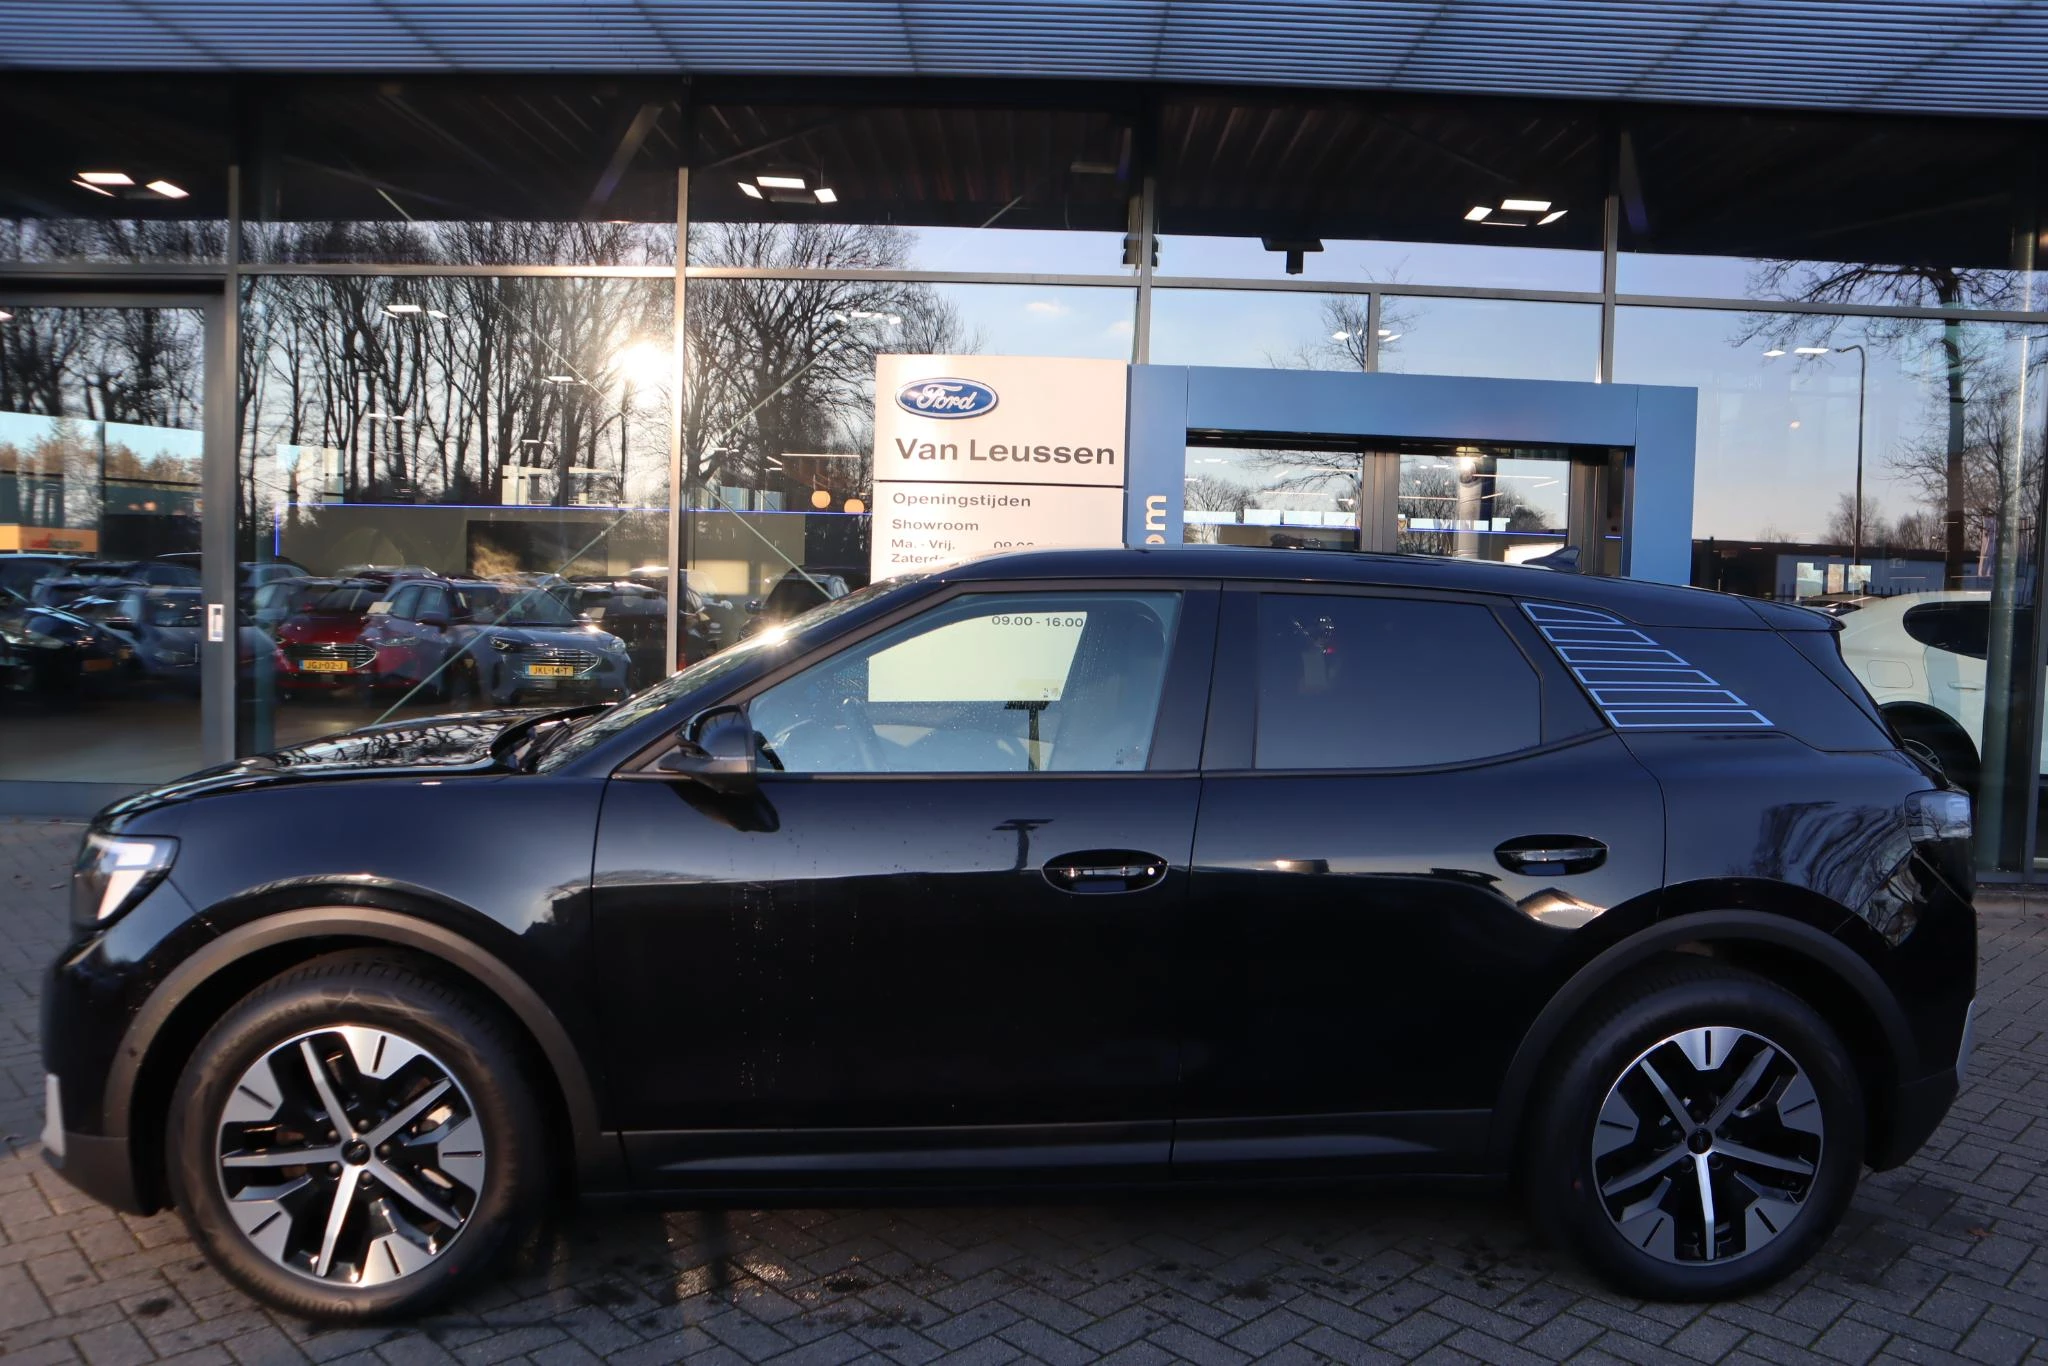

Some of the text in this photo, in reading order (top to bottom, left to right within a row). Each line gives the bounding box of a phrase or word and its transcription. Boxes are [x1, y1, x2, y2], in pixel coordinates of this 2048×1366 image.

[916, 384, 977, 409] Ford
[895, 438, 1115, 464] Van Leussen
[892, 493, 1031, 508] Openingstijden
[892, 519, 979, 530] Showroom
[891, 539, 917, 548] Ma.
[929, 539, 956, 551] Vrij.
[991, 615, 1033, 626] 09.00
[1045, 617, 1084, 627] 16.00
